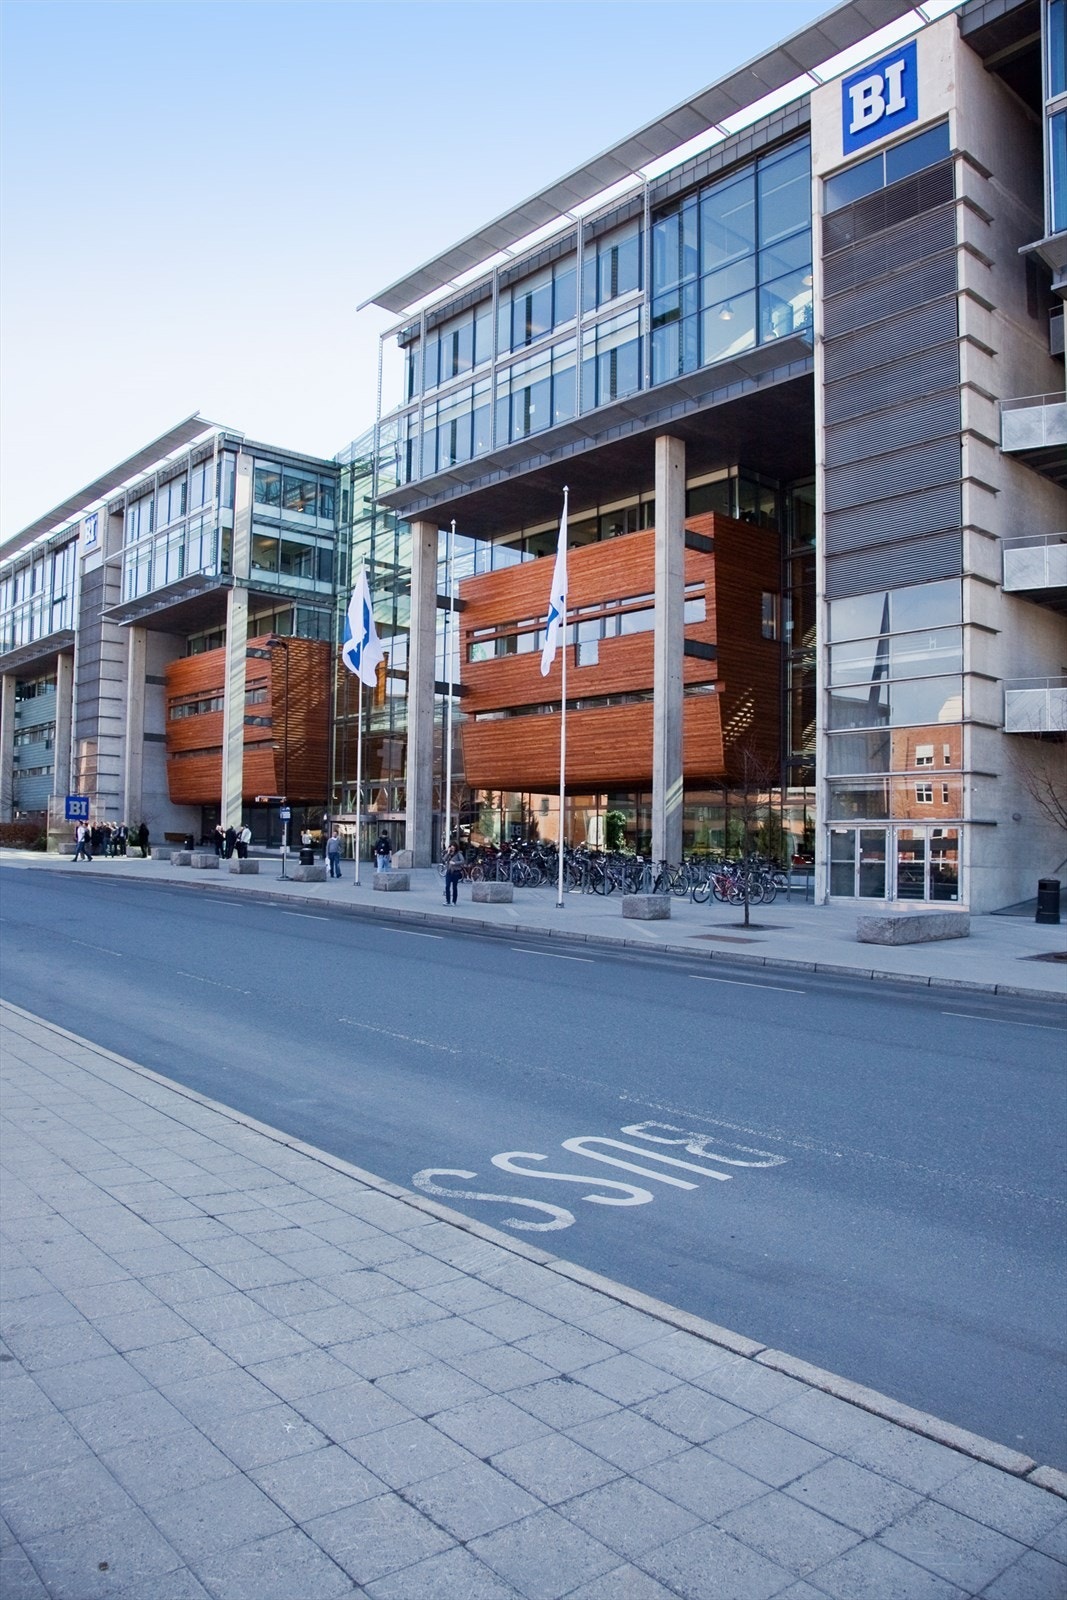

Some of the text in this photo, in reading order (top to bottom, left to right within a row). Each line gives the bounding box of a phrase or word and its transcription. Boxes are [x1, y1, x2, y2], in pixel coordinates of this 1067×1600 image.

[849, 59, 906, 134] BI
[69, 800, 87, 816] BI
[411, 1120, 792, 1232] BUSS
